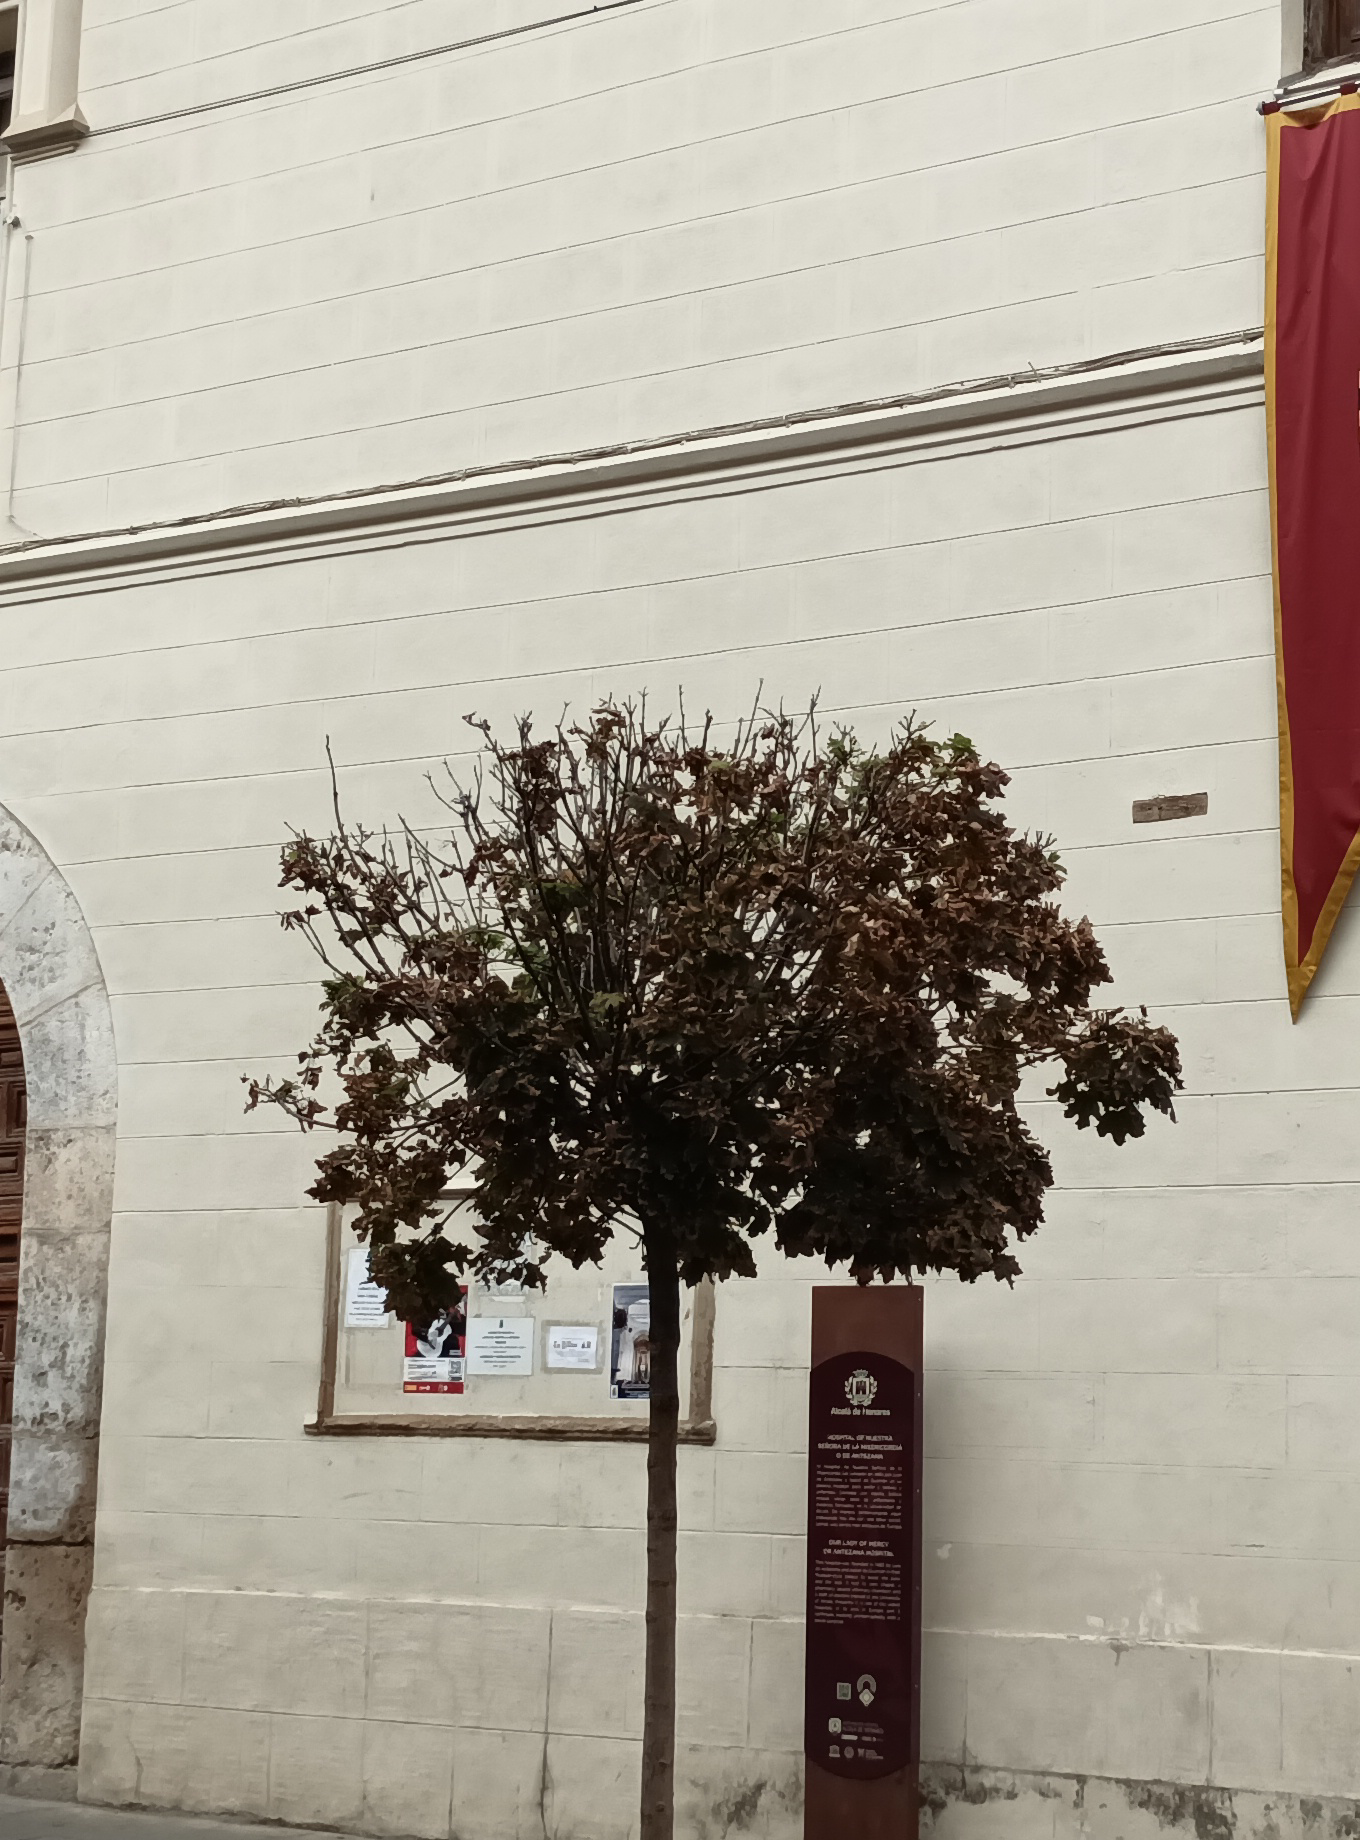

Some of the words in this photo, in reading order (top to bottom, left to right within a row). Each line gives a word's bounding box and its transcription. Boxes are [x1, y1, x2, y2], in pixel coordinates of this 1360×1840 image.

[830, 1406, 851, 1416] Alcalá
[852, 1406, 861, 1416] de
[862, 1406, 891, 1416] Henares
